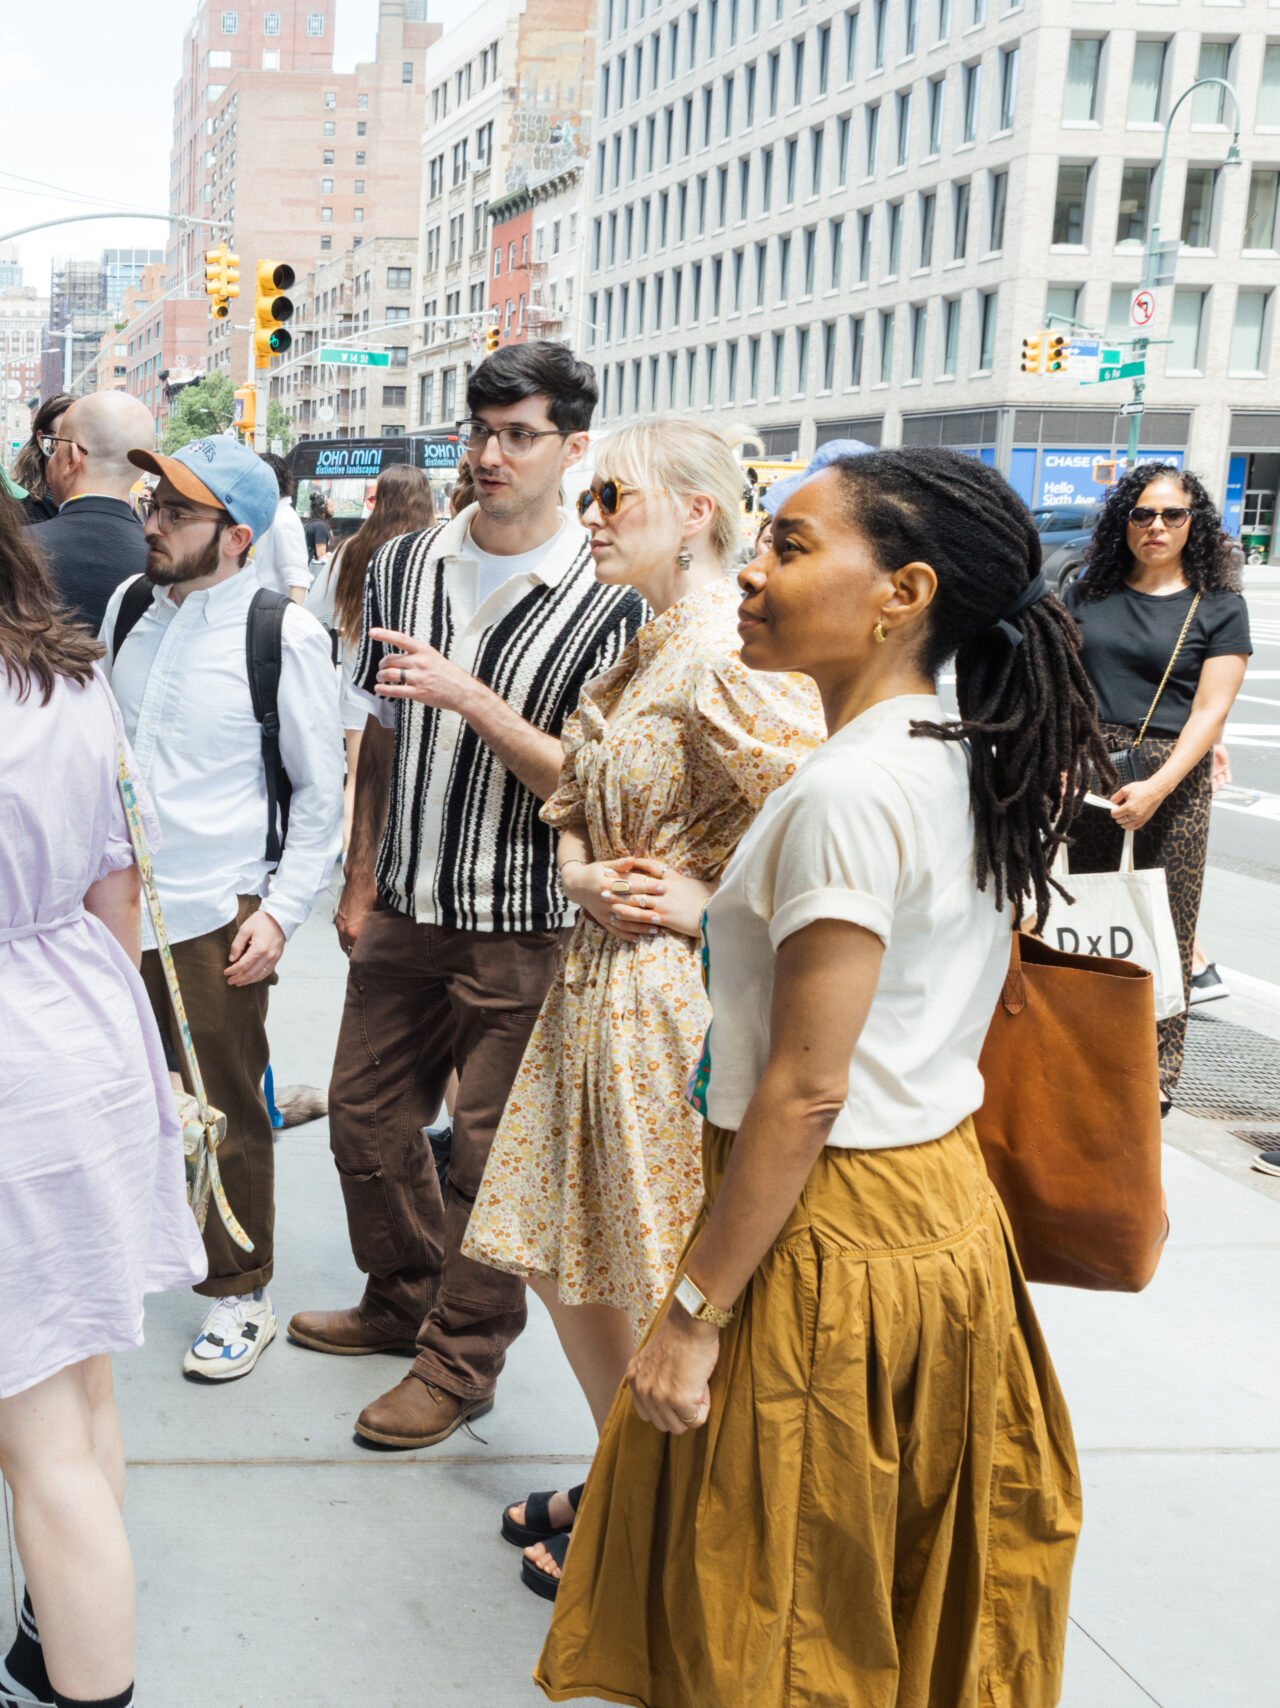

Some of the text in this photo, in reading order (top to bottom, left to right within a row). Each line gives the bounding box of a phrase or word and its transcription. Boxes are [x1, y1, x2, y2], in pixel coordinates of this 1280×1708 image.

[341, 353, 369, 364] W 14 St
[1104, 369, 1111, 379] 6
[424, 443, 453, 458] JOHN
[316, 448, 383, 466] JOHN MINI
[424, 457, 455, 468] distinctive
[1045, 455, 1091, 468] CHASE
[315, 464, 380, 476] distinctive landscapes
[1044, 482, 1075, 494] Hello
[1042, 494, 1072, 506] Sixth
[1056, 926, 1134, 959] DxD
